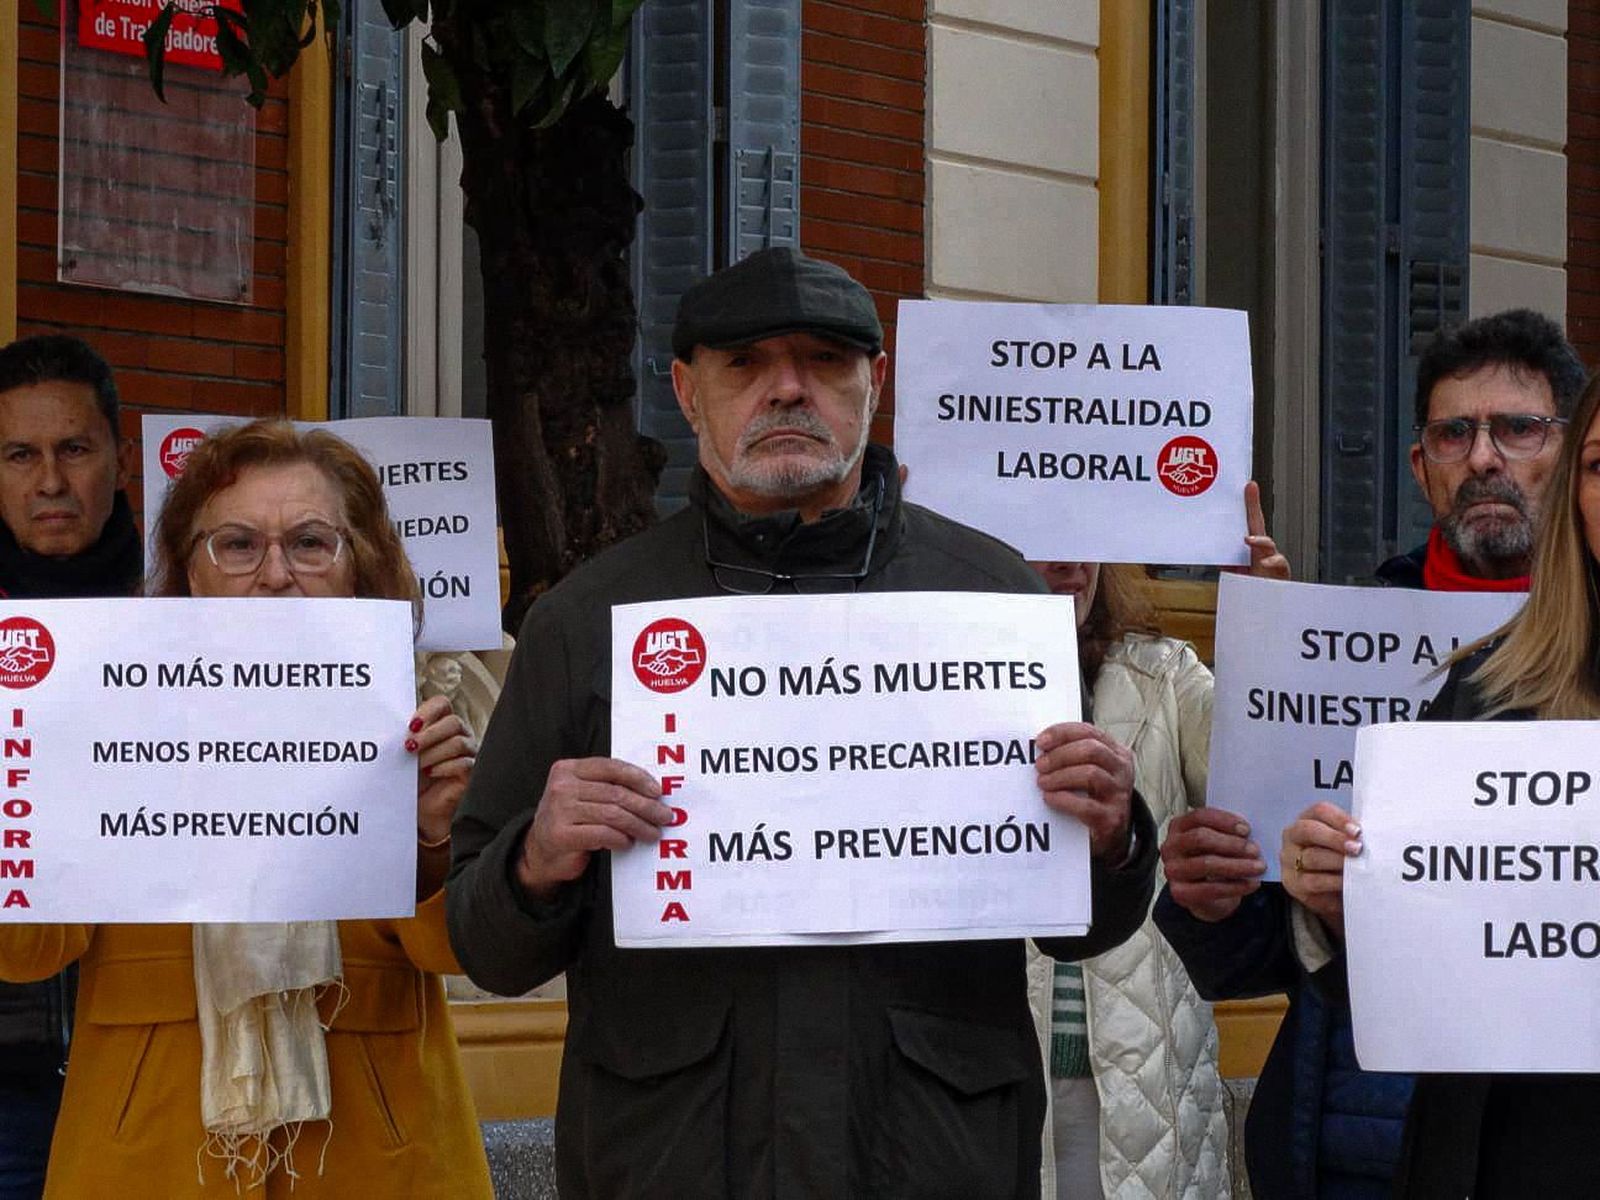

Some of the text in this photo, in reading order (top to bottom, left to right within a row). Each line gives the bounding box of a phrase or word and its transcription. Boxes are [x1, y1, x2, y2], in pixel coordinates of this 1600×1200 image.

[95, 12, 219, 55] de Trajadore
[991, 341, 1161, 371] STOP A LA
[938, 394, 1212, 427] SINIESTRALIDAD
[997, 451, 1151, 482] LABORAL
[1169, 447, 1206, 466] UGT
[0, 629, 39, 650] UGT
[646, 630, 690, 653] UGT
[1301, 628, 1400, 662] STOP
[1412, 635, 1439, 666] A
[0, 674, 37, 682] HUELVA
[103, 657, 371, 687] NO MÁS MUERTES
[711, 658, 1047, 697] NO MÁS MUERTES
[93, 741, 378, 762] MENOS PRECARIEDAD
[701, 746, 818, 774] MENOS
[1474, 771, 1591, 806] STOP
[1, 709, 34, 908] INFORMA
[100, 806, 359, 836] MÁS PREVENCIÓN
[709, 816, 1050, 862] MÁS PREVENCIÓN
[1402, 845, 1600, 881] SINIESTR
[1484, 922, 1600, 959] LABO
